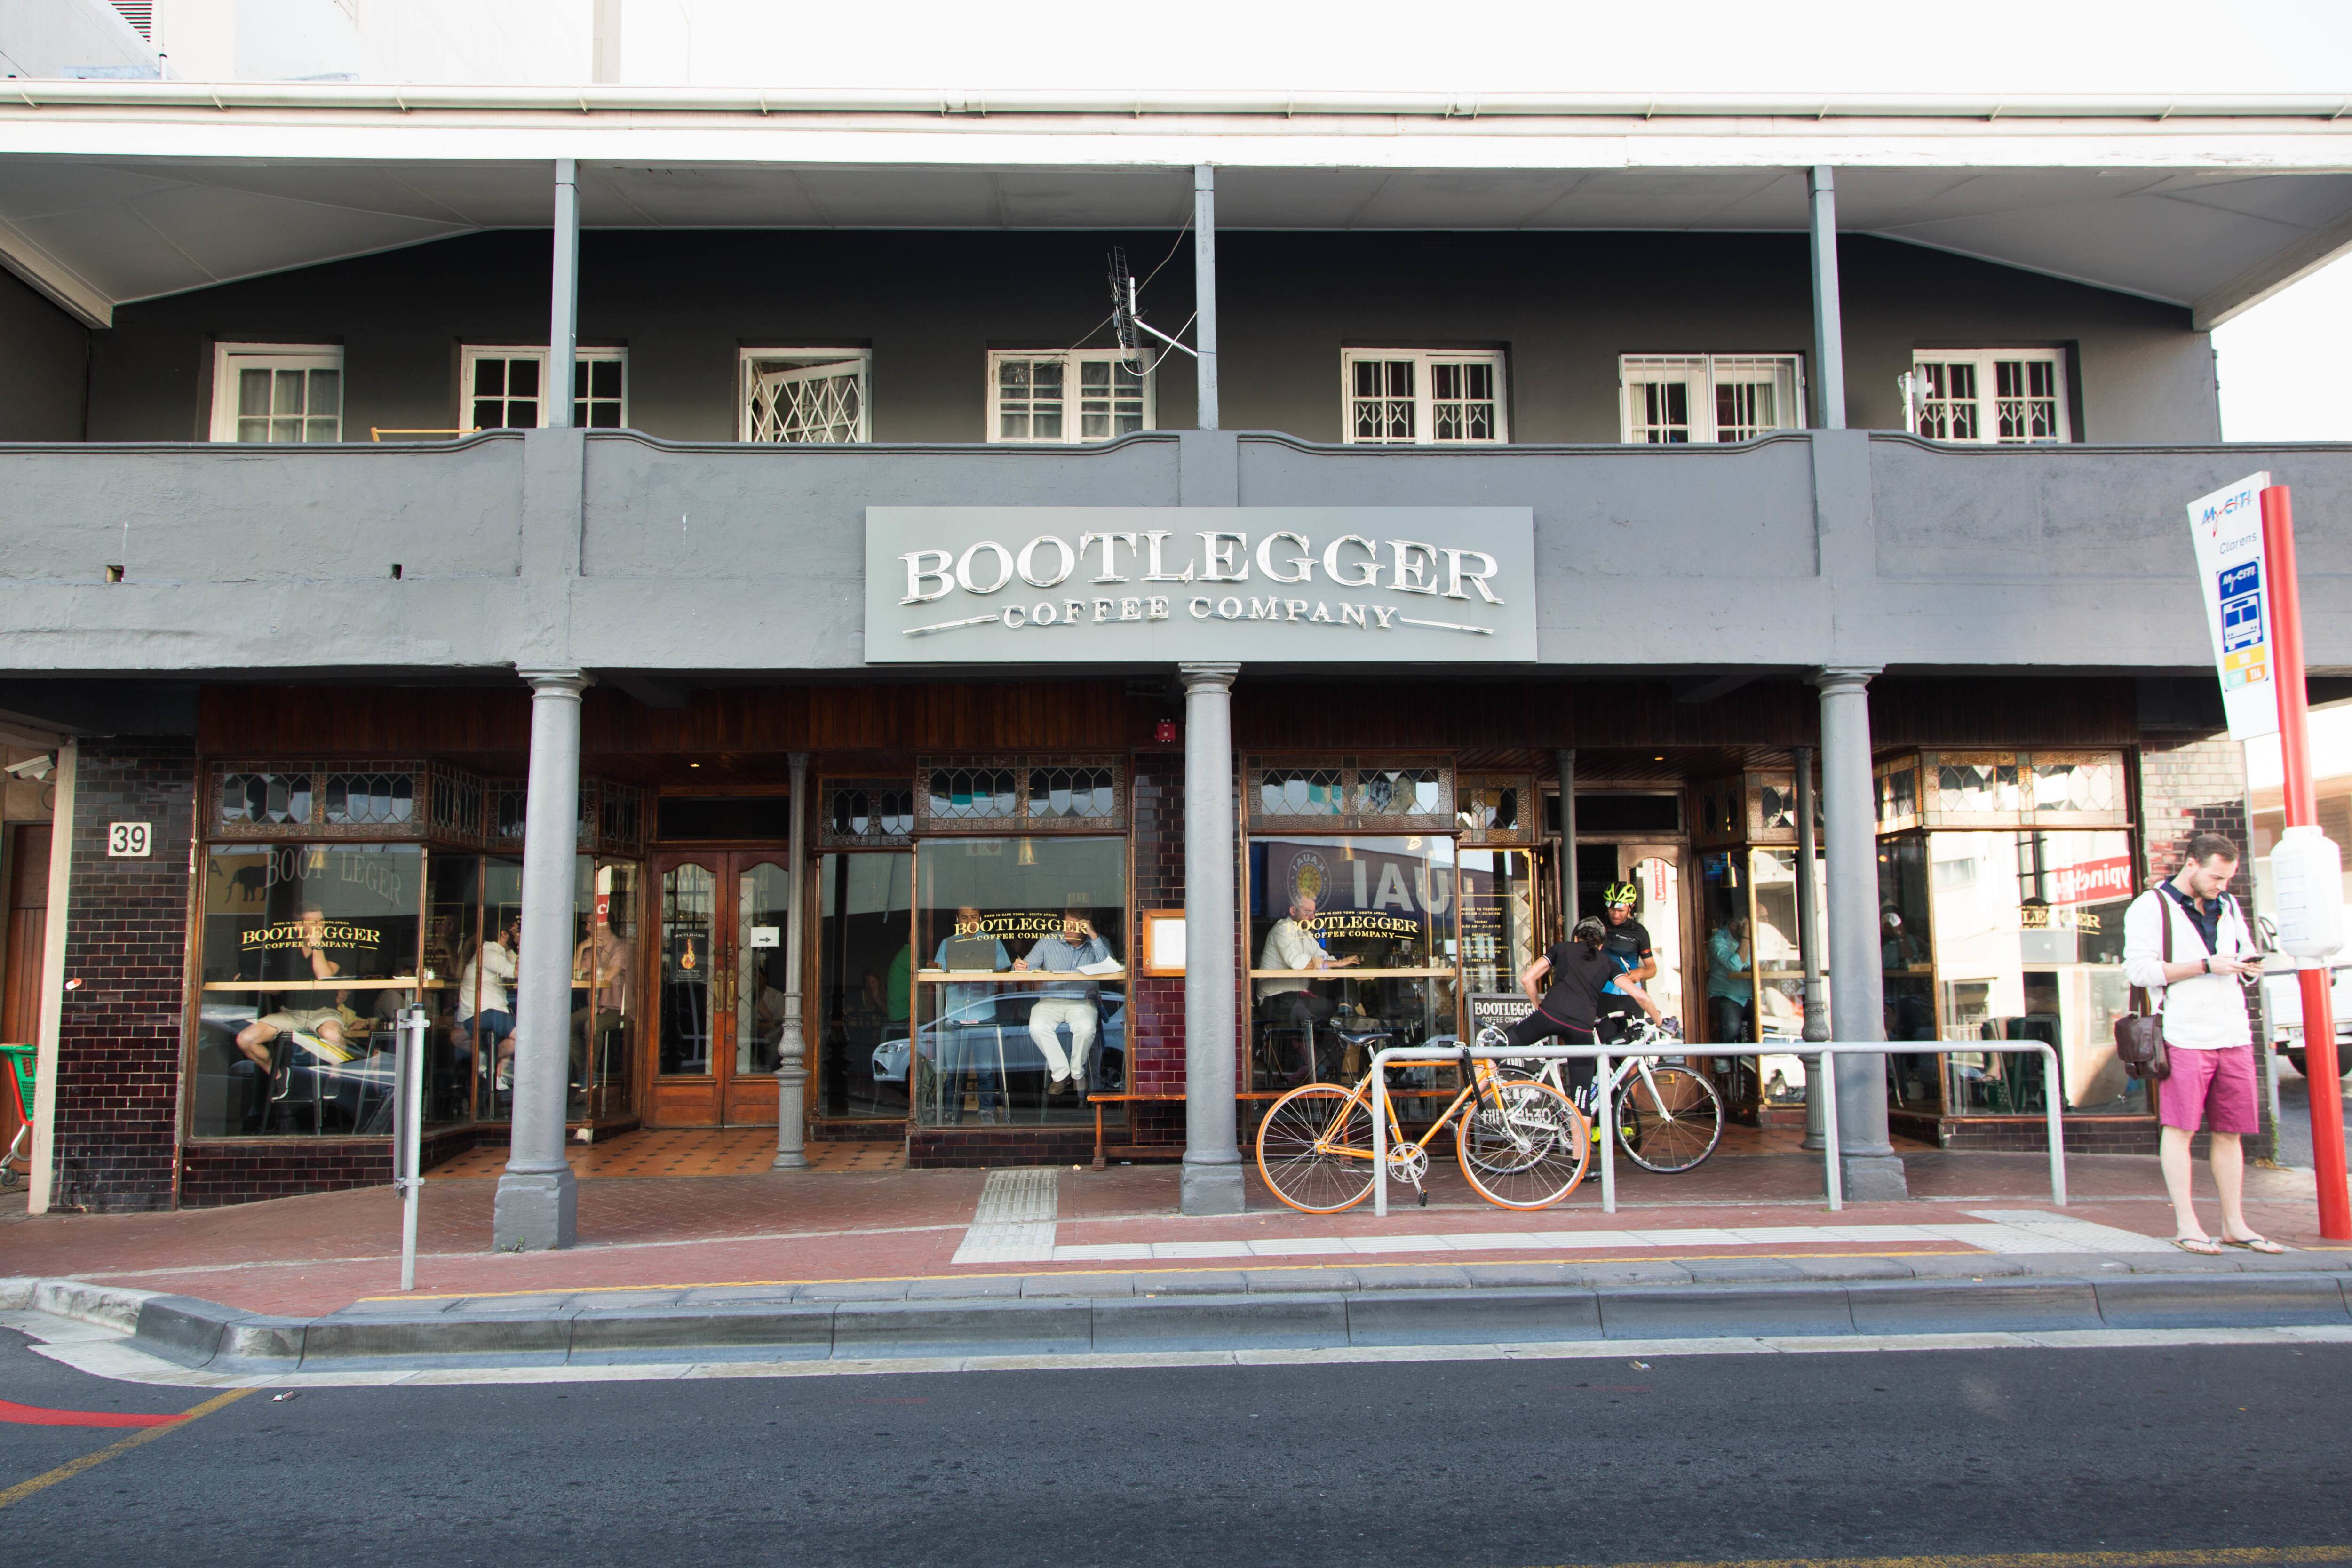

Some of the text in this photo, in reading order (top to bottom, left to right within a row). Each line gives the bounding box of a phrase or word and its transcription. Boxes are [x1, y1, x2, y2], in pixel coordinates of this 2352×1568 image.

[2220, 533, 2257, 554] Clarens
[898, 530, 1505, 605] BOOTLEGGER
[1002, 595, 1397, 629] COFFEE COMPANY
[113, 826, 146, 853] 39
[242, 926, 380, 944] BOOTLEGGER
[954, 918, 1088, 936] BOOTLEGGER
[1474, 1002, 1537, 1015] BOOTLEGG
